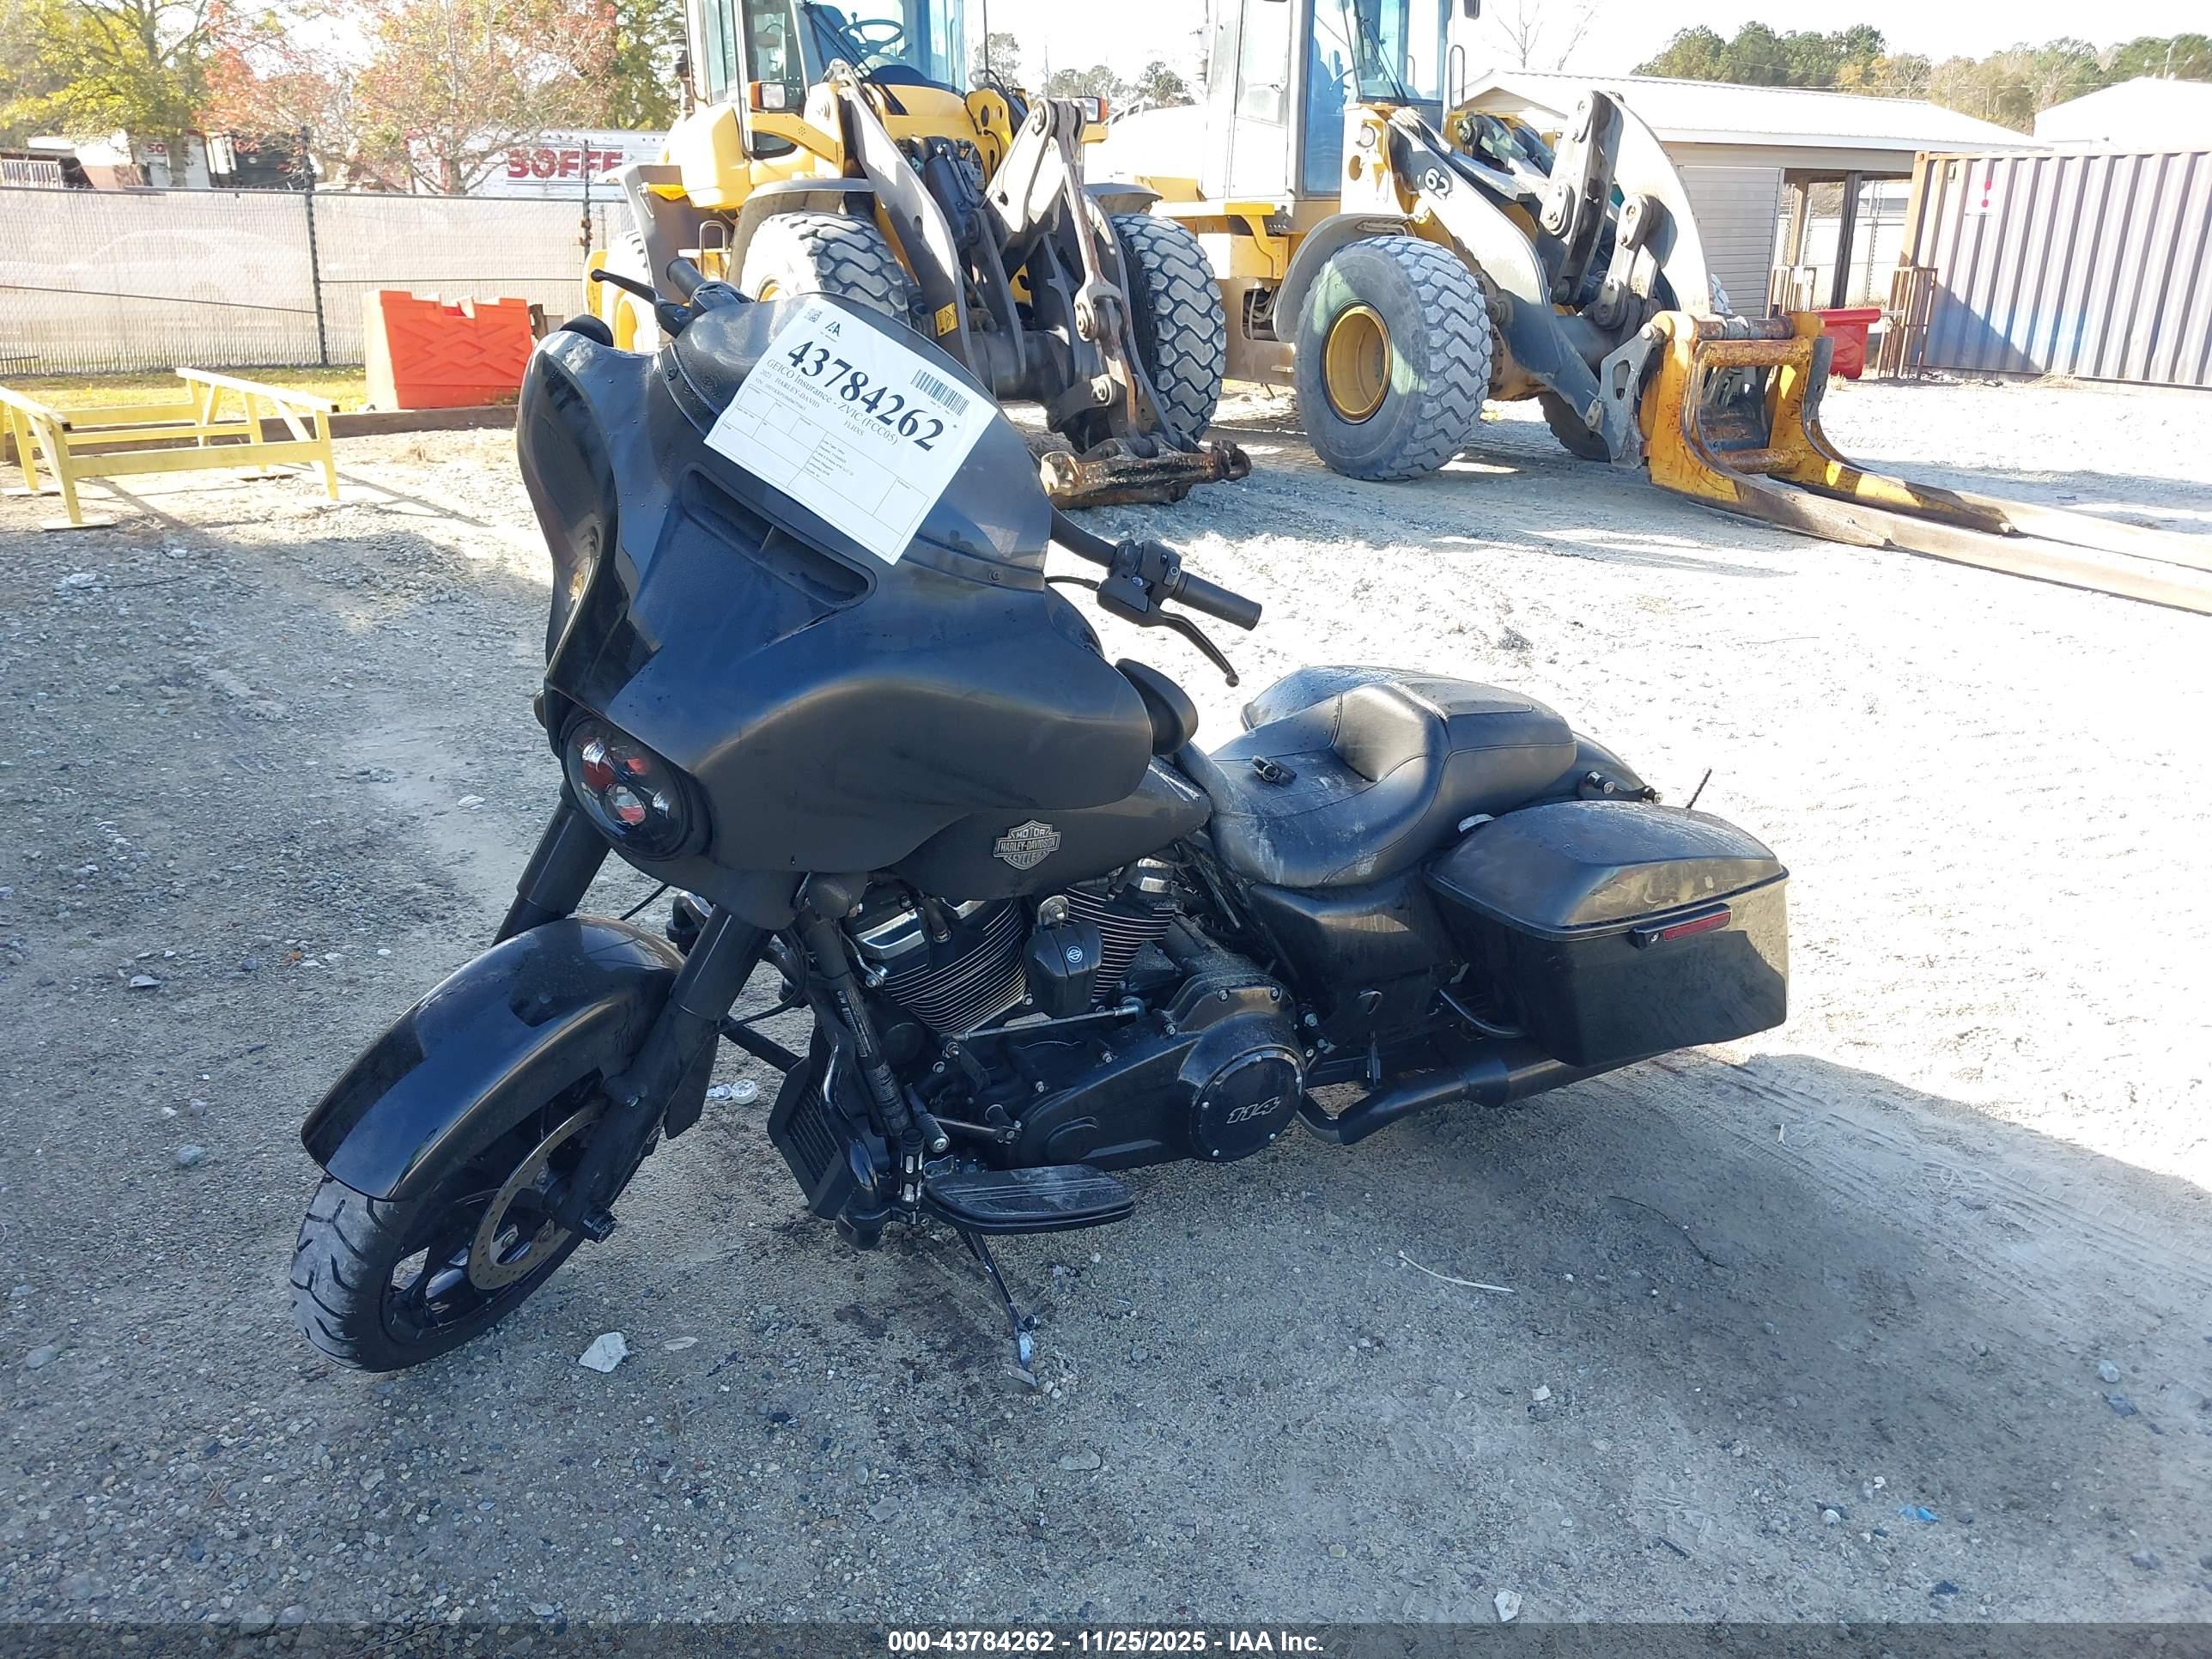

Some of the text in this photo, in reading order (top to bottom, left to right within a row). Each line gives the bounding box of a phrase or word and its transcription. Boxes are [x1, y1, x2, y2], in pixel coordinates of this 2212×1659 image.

[767, 359, 795, 378] GEICO
[795, 374, 833, 404] Insurance
[836, 402, 863, 421] ZVIC
[861, 417, 899, 447] (FCC05)
[787, 341, 944, 452] 43784262
[1001, 837, 1056, 853] HARLEY-DAVIDSON
[1017, 827, 1045, 838] MOTOR
[1226, 1096, 1280, 1124] 114
